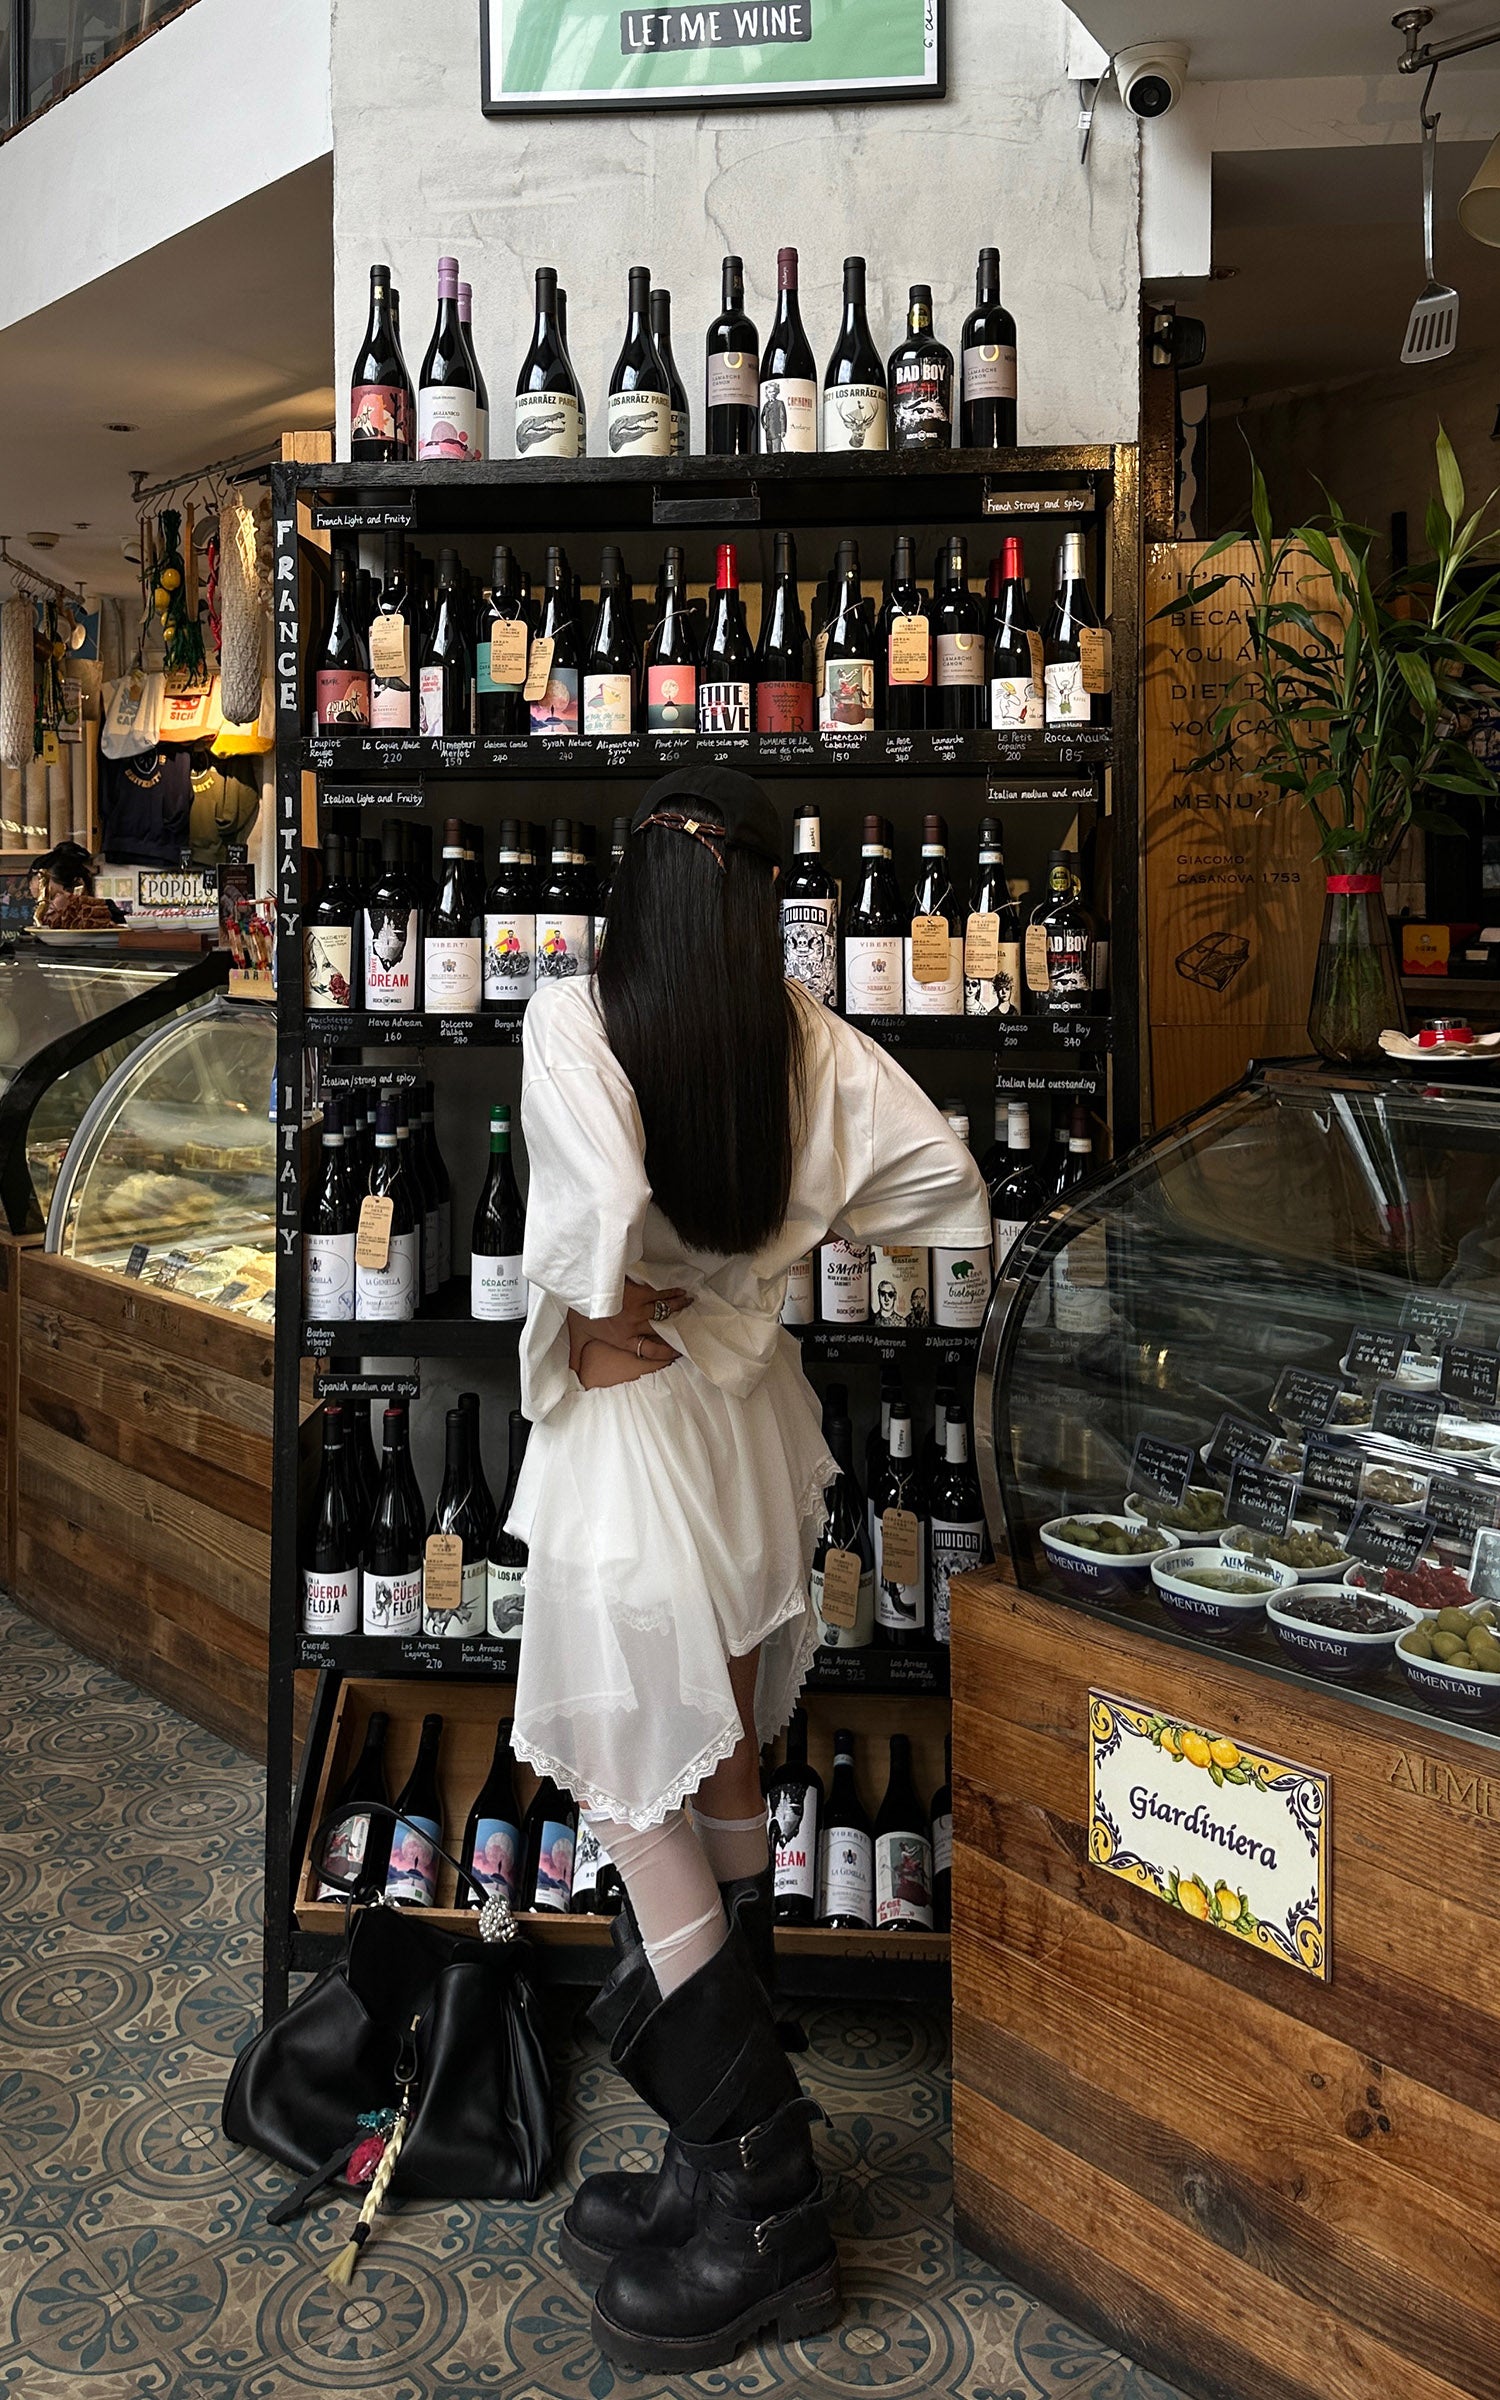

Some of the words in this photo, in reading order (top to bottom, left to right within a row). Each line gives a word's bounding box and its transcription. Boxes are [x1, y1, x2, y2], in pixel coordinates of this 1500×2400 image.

[628, 14, 672, 47] LET
[680, 11, 722, 42] ME
[733, 4, 803, 39] WINE
[896, 364, 921, 382] BAD
[923, 363, 946, 382] BOY
[835, 389, 848, 400] LOS
[987, 499, 1012, 512] French
[1013, 500, 1040, 512] Strong
[1044, 498, 1060, 509] and
[1064, 497, 1085, 511] spicy
[316, 514, 343, 527] French
[343, 515, 363, 528] Light
[366, 514, 381, 524] and
[384, 514, 411, 527] Fruity
[276, 519, 299, 712] FRANCE
[1171, 609, 1294, 630] BECA
[1169, 647, 1222, 663] YOU
[819, 732, 867, 742] Alimentari
[931, 734, 965, 745] Lamarche
[997, 733, 1008, 742] Le
[1011, 733, 1032, 742] Petit
[1043, 733, 1074, 743] Rocca
[309, 739, 341, 748] Loupiot
[362, 740, 371, 749] Le
[431, 739, 476, 750] Alimentari
[541, 739, 565, 750] Syrah
[596, 740, 640, 750] Alimentari
[309, 749, 334, 758] Rouge
[382, 753, 402, 763] 220
[440, 749, 470, 758] Merlot
[558, 751, 573, 760] 240
[659, 752, 680, 761] 260
[714, 752, 729, 760] 220
[832, 751, 850, 762] 150
[894, 753, 909, 762] 340
[1005, 751, 1021, 761] 200
[1058, 748, 1082, 762] 185
[317, 758, 334, 767] 240
[444, 758, 463, 767] 150
[1300, 754, 1339, 772] TH
[323, 793, 356, 804] Italian
[377, 792, 393, 803] and
[988, 788, 1017, 800] Italian
[1051, 787, 1068, 798] and
[1071, 787, 1093, 798] mild
[280, 794, 299, 936] ITALY
[1177, 873, 1256, 884] CASANOVA
[1262, 871, 1302, 884] 1753
[1046, 936, 1063, 952] AD
[1065, 936, 1088, 952] BOY
[494, 1019, 515, 1030] Borga
[998, 1022, 1028, 1033] Ripasso
[1052, 1022, 1069, 1033] Bad
[1075, 1023, 1091, 1038] Boy
[384, 1031, 402, 1042] 160
[1004, 1037, 1018, 1046] 500
[1063, 1037, 1081, 1047] 340
[379, 1072, 393, 1083] and
[396, 1072, 416, 1087] spicy
[996, 1075, 1026, 1088] Italian
[1027, 1076, 1046, 1089] bold
[1048, 1077, 1096, 1094] outstanding
[279, 1084, 299, 1255] ITALY
[873, 1337, 907, 1348] Amarone
[318, 1379, 349, 1397] Spanish
[380, 1382, 394, 1392] and
[397, 1381, 418, 1396] spicy
[1046, 1550, 1098, 1578] ALIMENTARI
[497, 1570, 511, 1581] LOS
[308, 1583, 348, 1600] CUERDA
[308, 1597, 341, 1614] FLOJA
[1159, 1591, 1220, 1618] ALIMENTARI
[401, 1642, 413, 1650] Los
[461, 1643, 474, 1652] Los
[1278, 1627, 1348, 1657] ALIMENTARI
[320, 1658, 336, 1667] 220
[426, 1659, 443, 1669] 270
[819, 1655, 833, 1664] Los
[889, 1659, 902, 1667] Los
[492, 1660, 507, 1671] 375
[846, 1669, 867, 1680] 325
[1407, 1667, 1483, 1698] ALIMENTARI
[1128, 1785, 1279, 1871] Giardiniera
[775, 1850, 807, 1868] REAM
